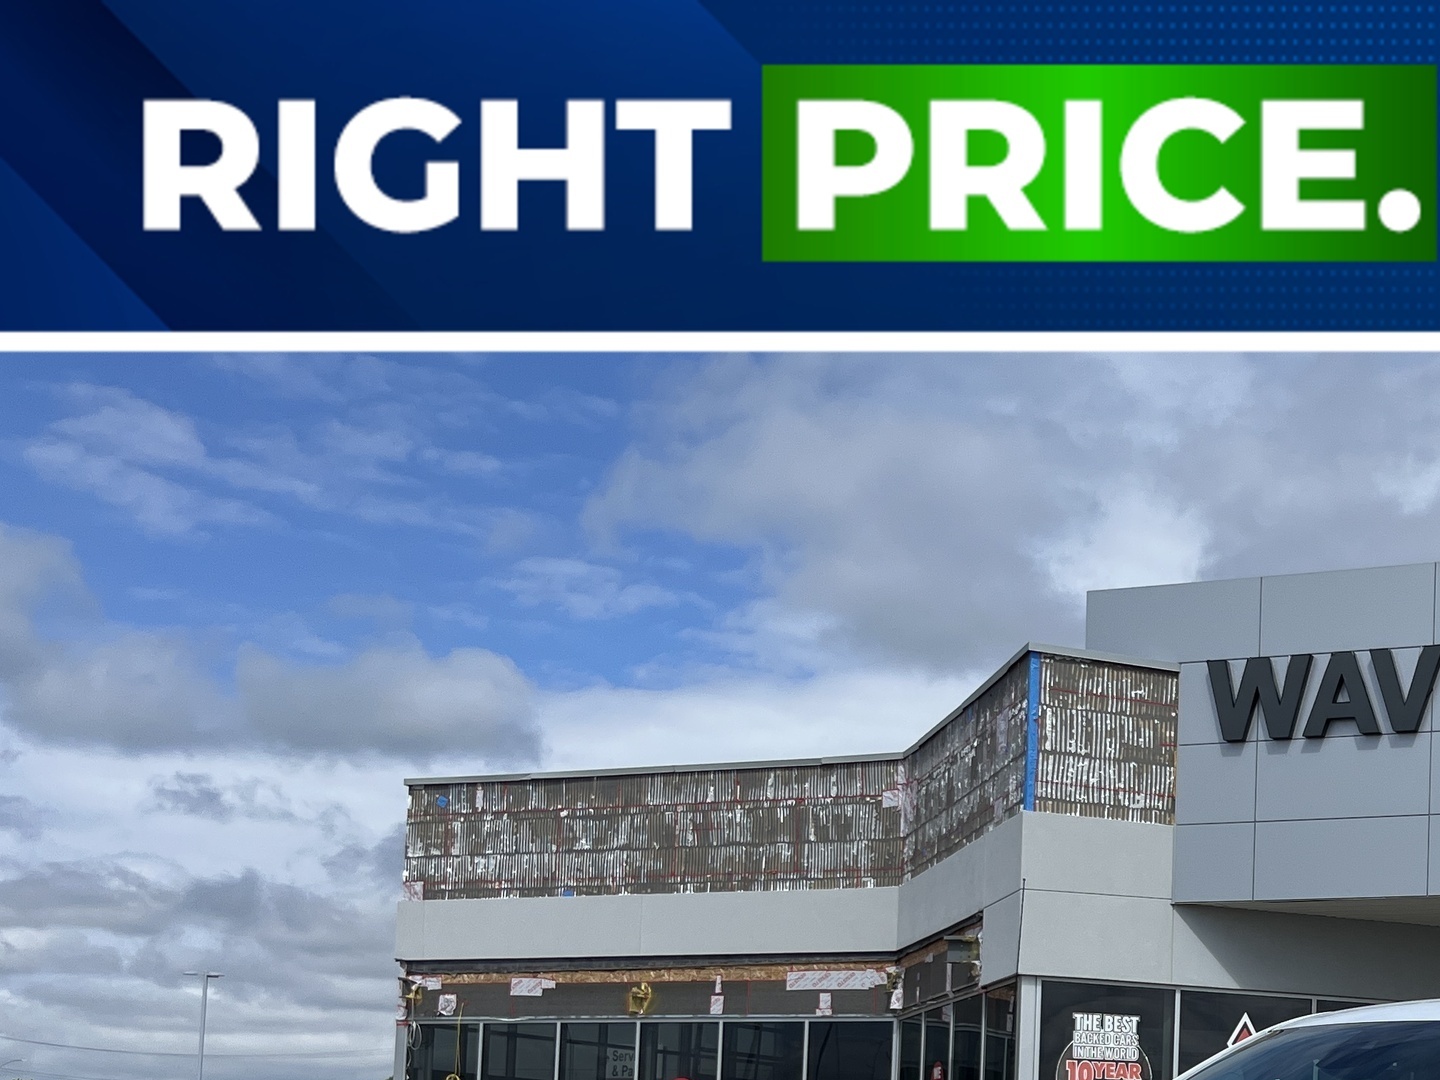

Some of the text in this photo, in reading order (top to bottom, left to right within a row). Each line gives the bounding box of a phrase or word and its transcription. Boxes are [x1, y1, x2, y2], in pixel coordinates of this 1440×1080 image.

[1073, 1013, 1140, 1034] THE BEST
[1073, 1032, 1139, 1046] BACKED CARS
[612, 1050, 635, 1062] Serv
[1074, 1046, 1139, 1060] IN THE WORLD
[612, 1065, 619, 1077] &
[1093, 1061, 1142, 1080] YEAR
